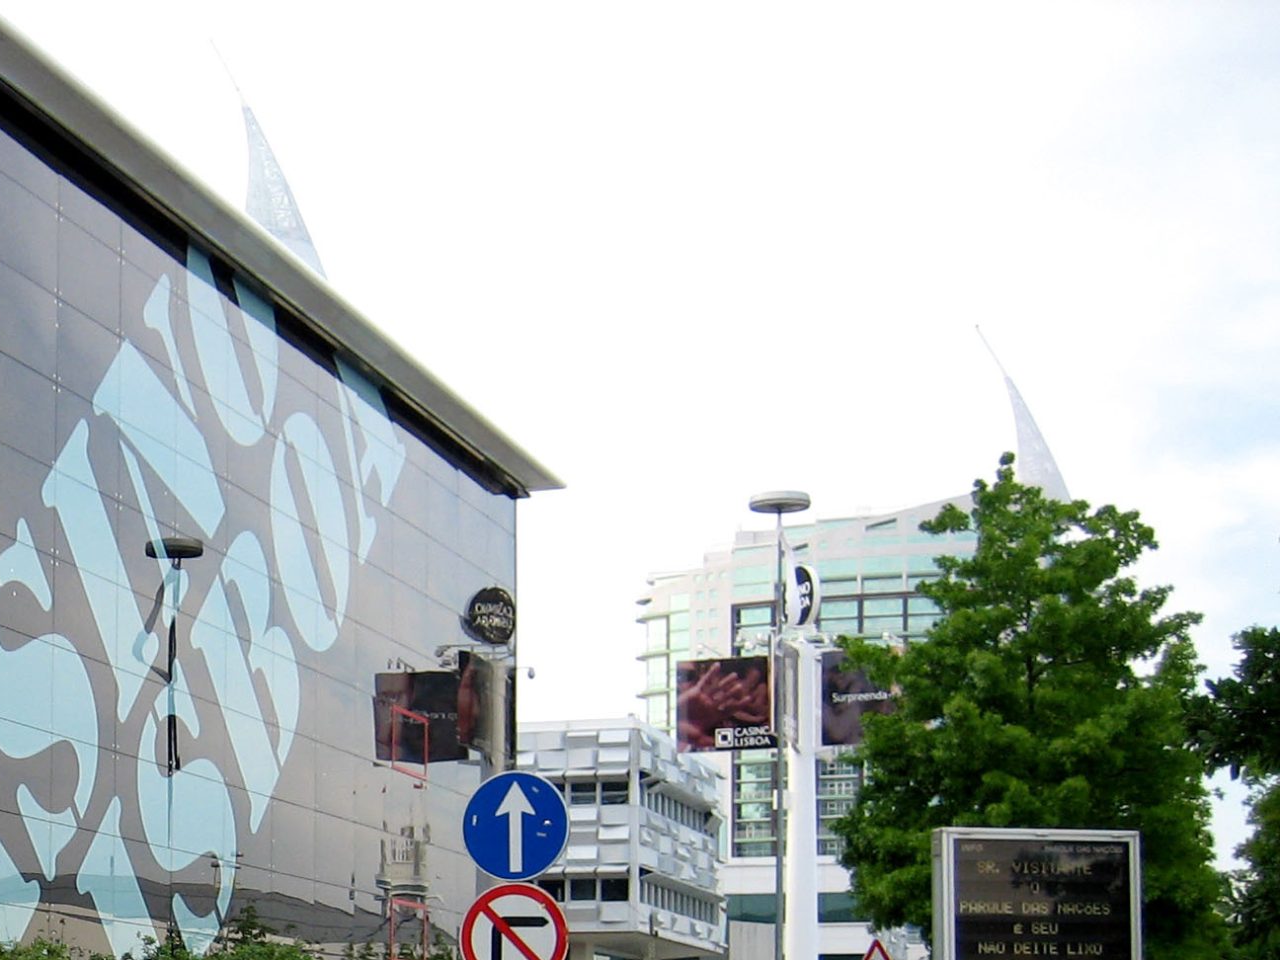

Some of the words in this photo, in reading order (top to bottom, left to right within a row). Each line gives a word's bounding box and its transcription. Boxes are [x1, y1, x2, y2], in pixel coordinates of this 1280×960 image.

[734, 736, 771, 747] LISBOA
[959, 901, 1013, 914] PARQUE
[1022, 902, 1049, 914] DAS
[1031, 922, 1059, 935] SEU
[1013, 943, 1058, 955] DEITE
[1067, 943, 1103, 955] LIXO
